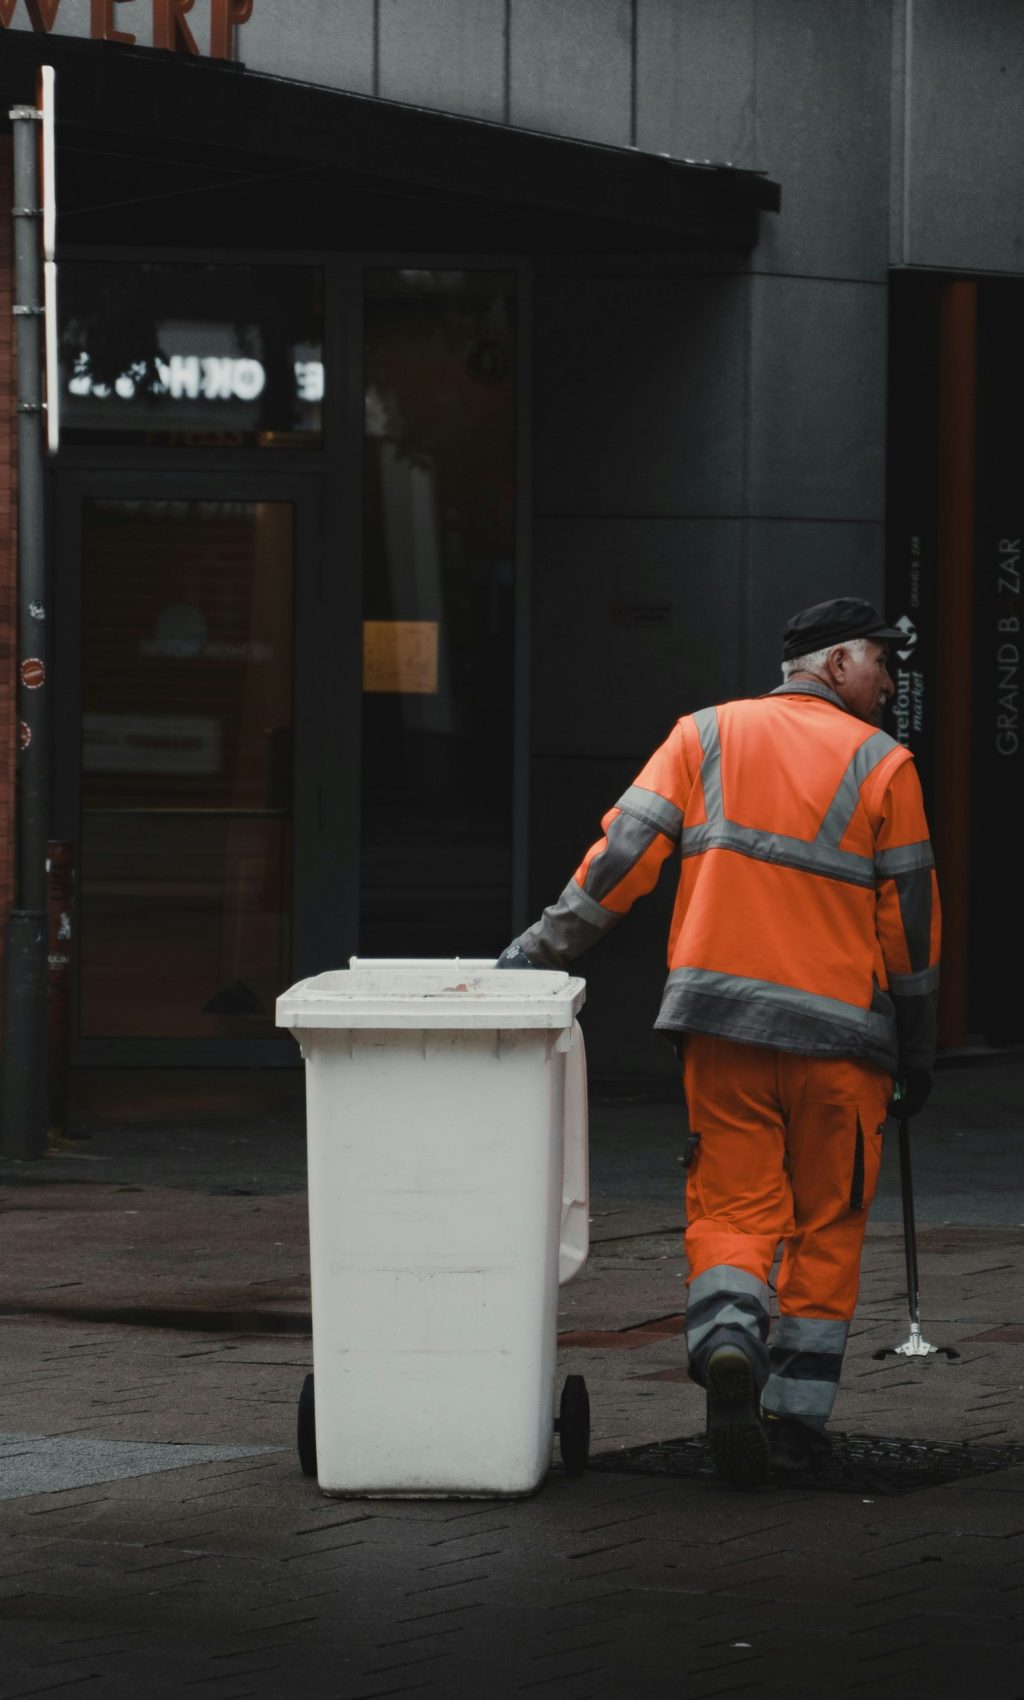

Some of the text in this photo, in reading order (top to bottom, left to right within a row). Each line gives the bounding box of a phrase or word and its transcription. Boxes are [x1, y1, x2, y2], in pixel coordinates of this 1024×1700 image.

[912, 671, 924, 731] market
[996, 538, 1021, 755] GRAND BZAR
